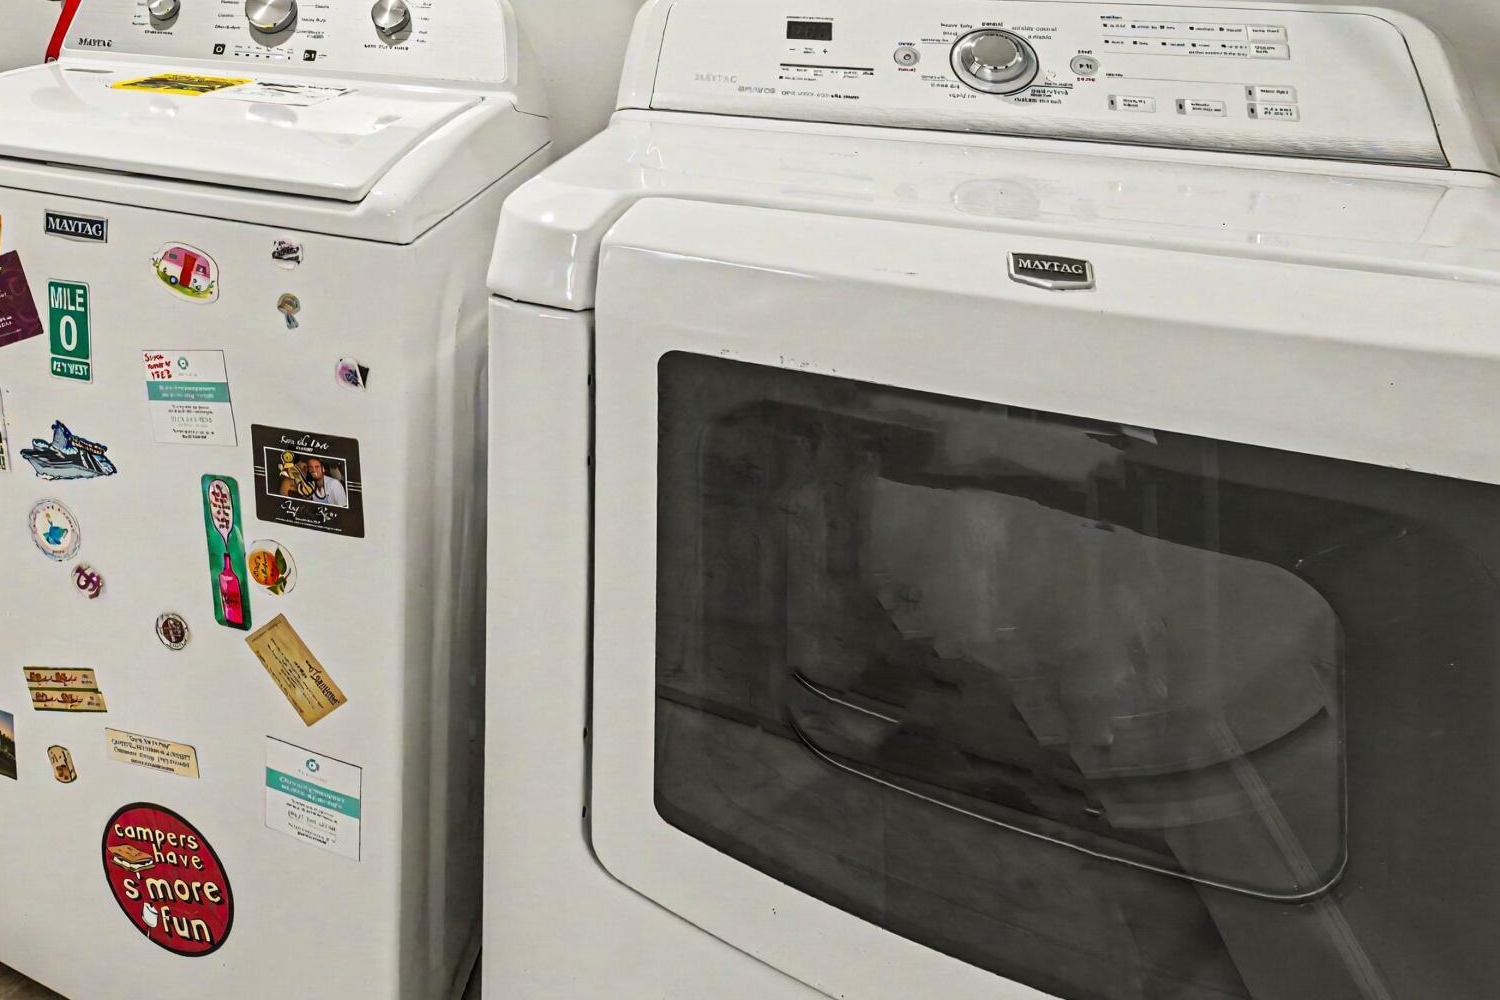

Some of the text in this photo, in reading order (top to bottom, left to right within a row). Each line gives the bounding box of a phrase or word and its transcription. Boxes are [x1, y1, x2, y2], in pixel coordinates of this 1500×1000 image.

[48, 216, 103, 237] MAYTAG
[1018, 259, 1084, 274] MAYTAG
[50, 286, 85, 312] MILE
[59, 315, 78, 352] 0
[114, 823, 199, 850] campers
[152, 843, 204, 869] have
[123, 872, 221, 903] s'more
[160, 905, 211, 942] fun
